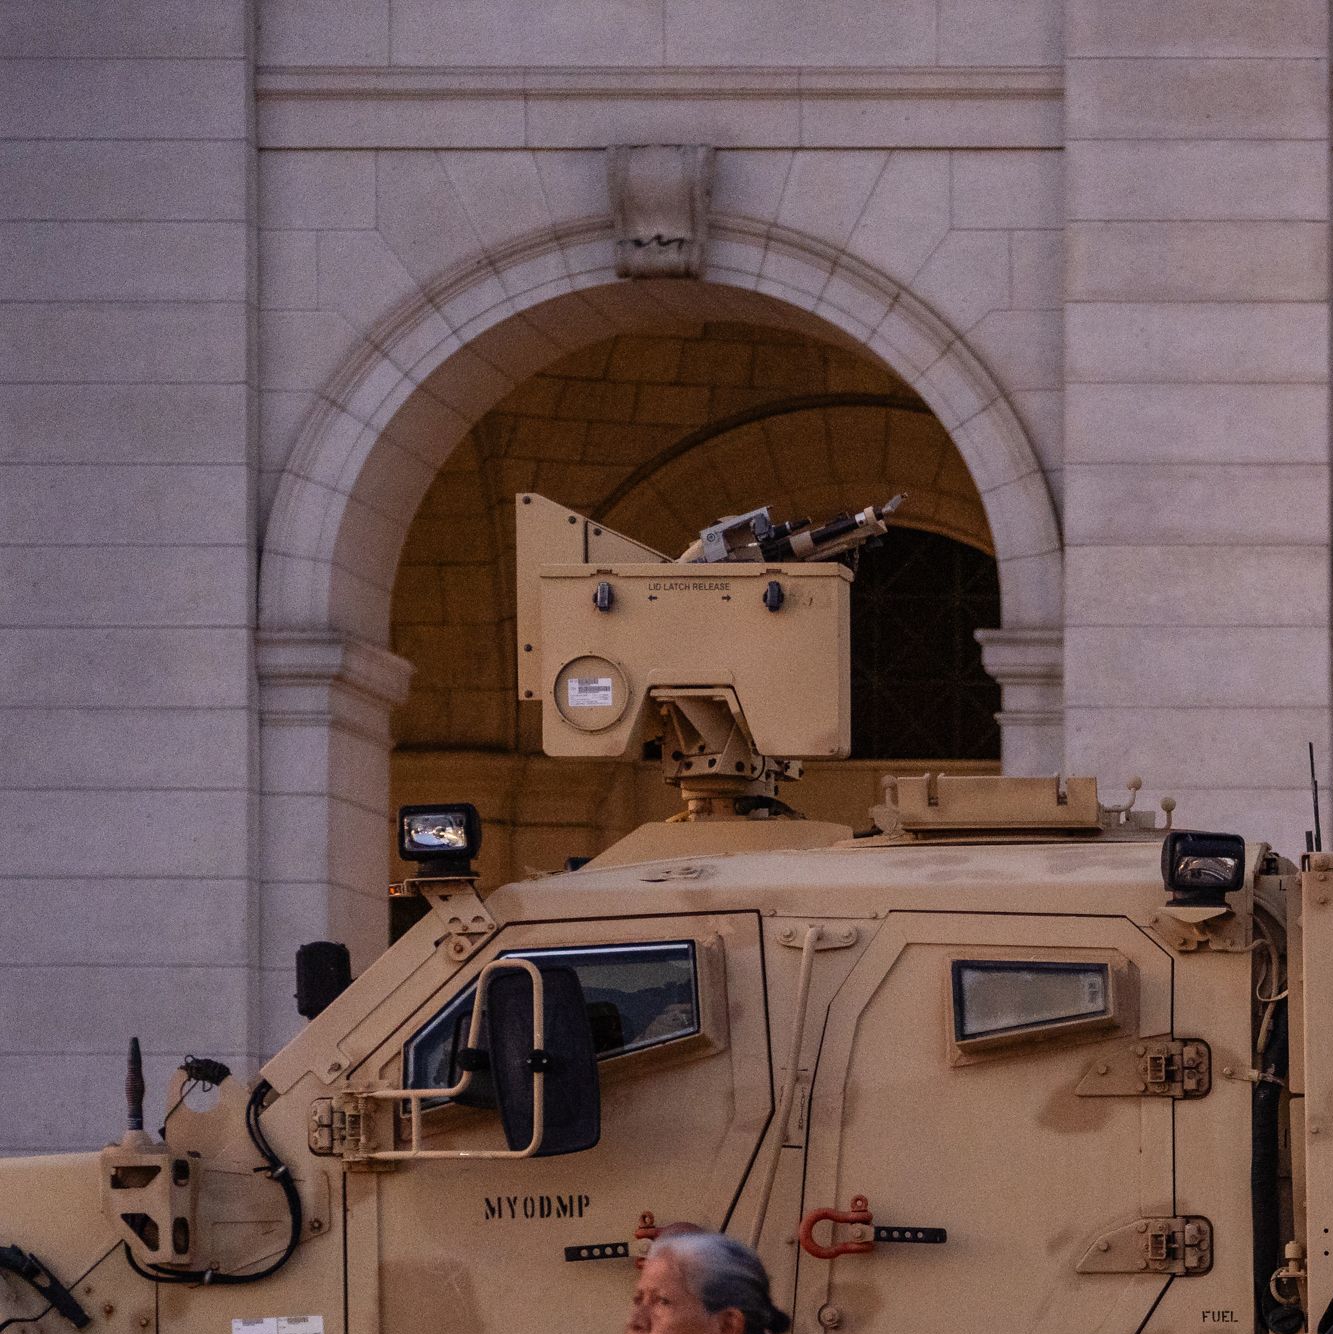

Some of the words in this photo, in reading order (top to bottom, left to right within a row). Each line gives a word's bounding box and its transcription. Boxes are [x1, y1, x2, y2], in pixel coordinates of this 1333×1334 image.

[648, 583, 661, 591] LID
[663, 583, 690, 591] LATCH
[692, 583, 731, 591] RELEASE
[1202, 1310, 1239, 1323] FUEL
